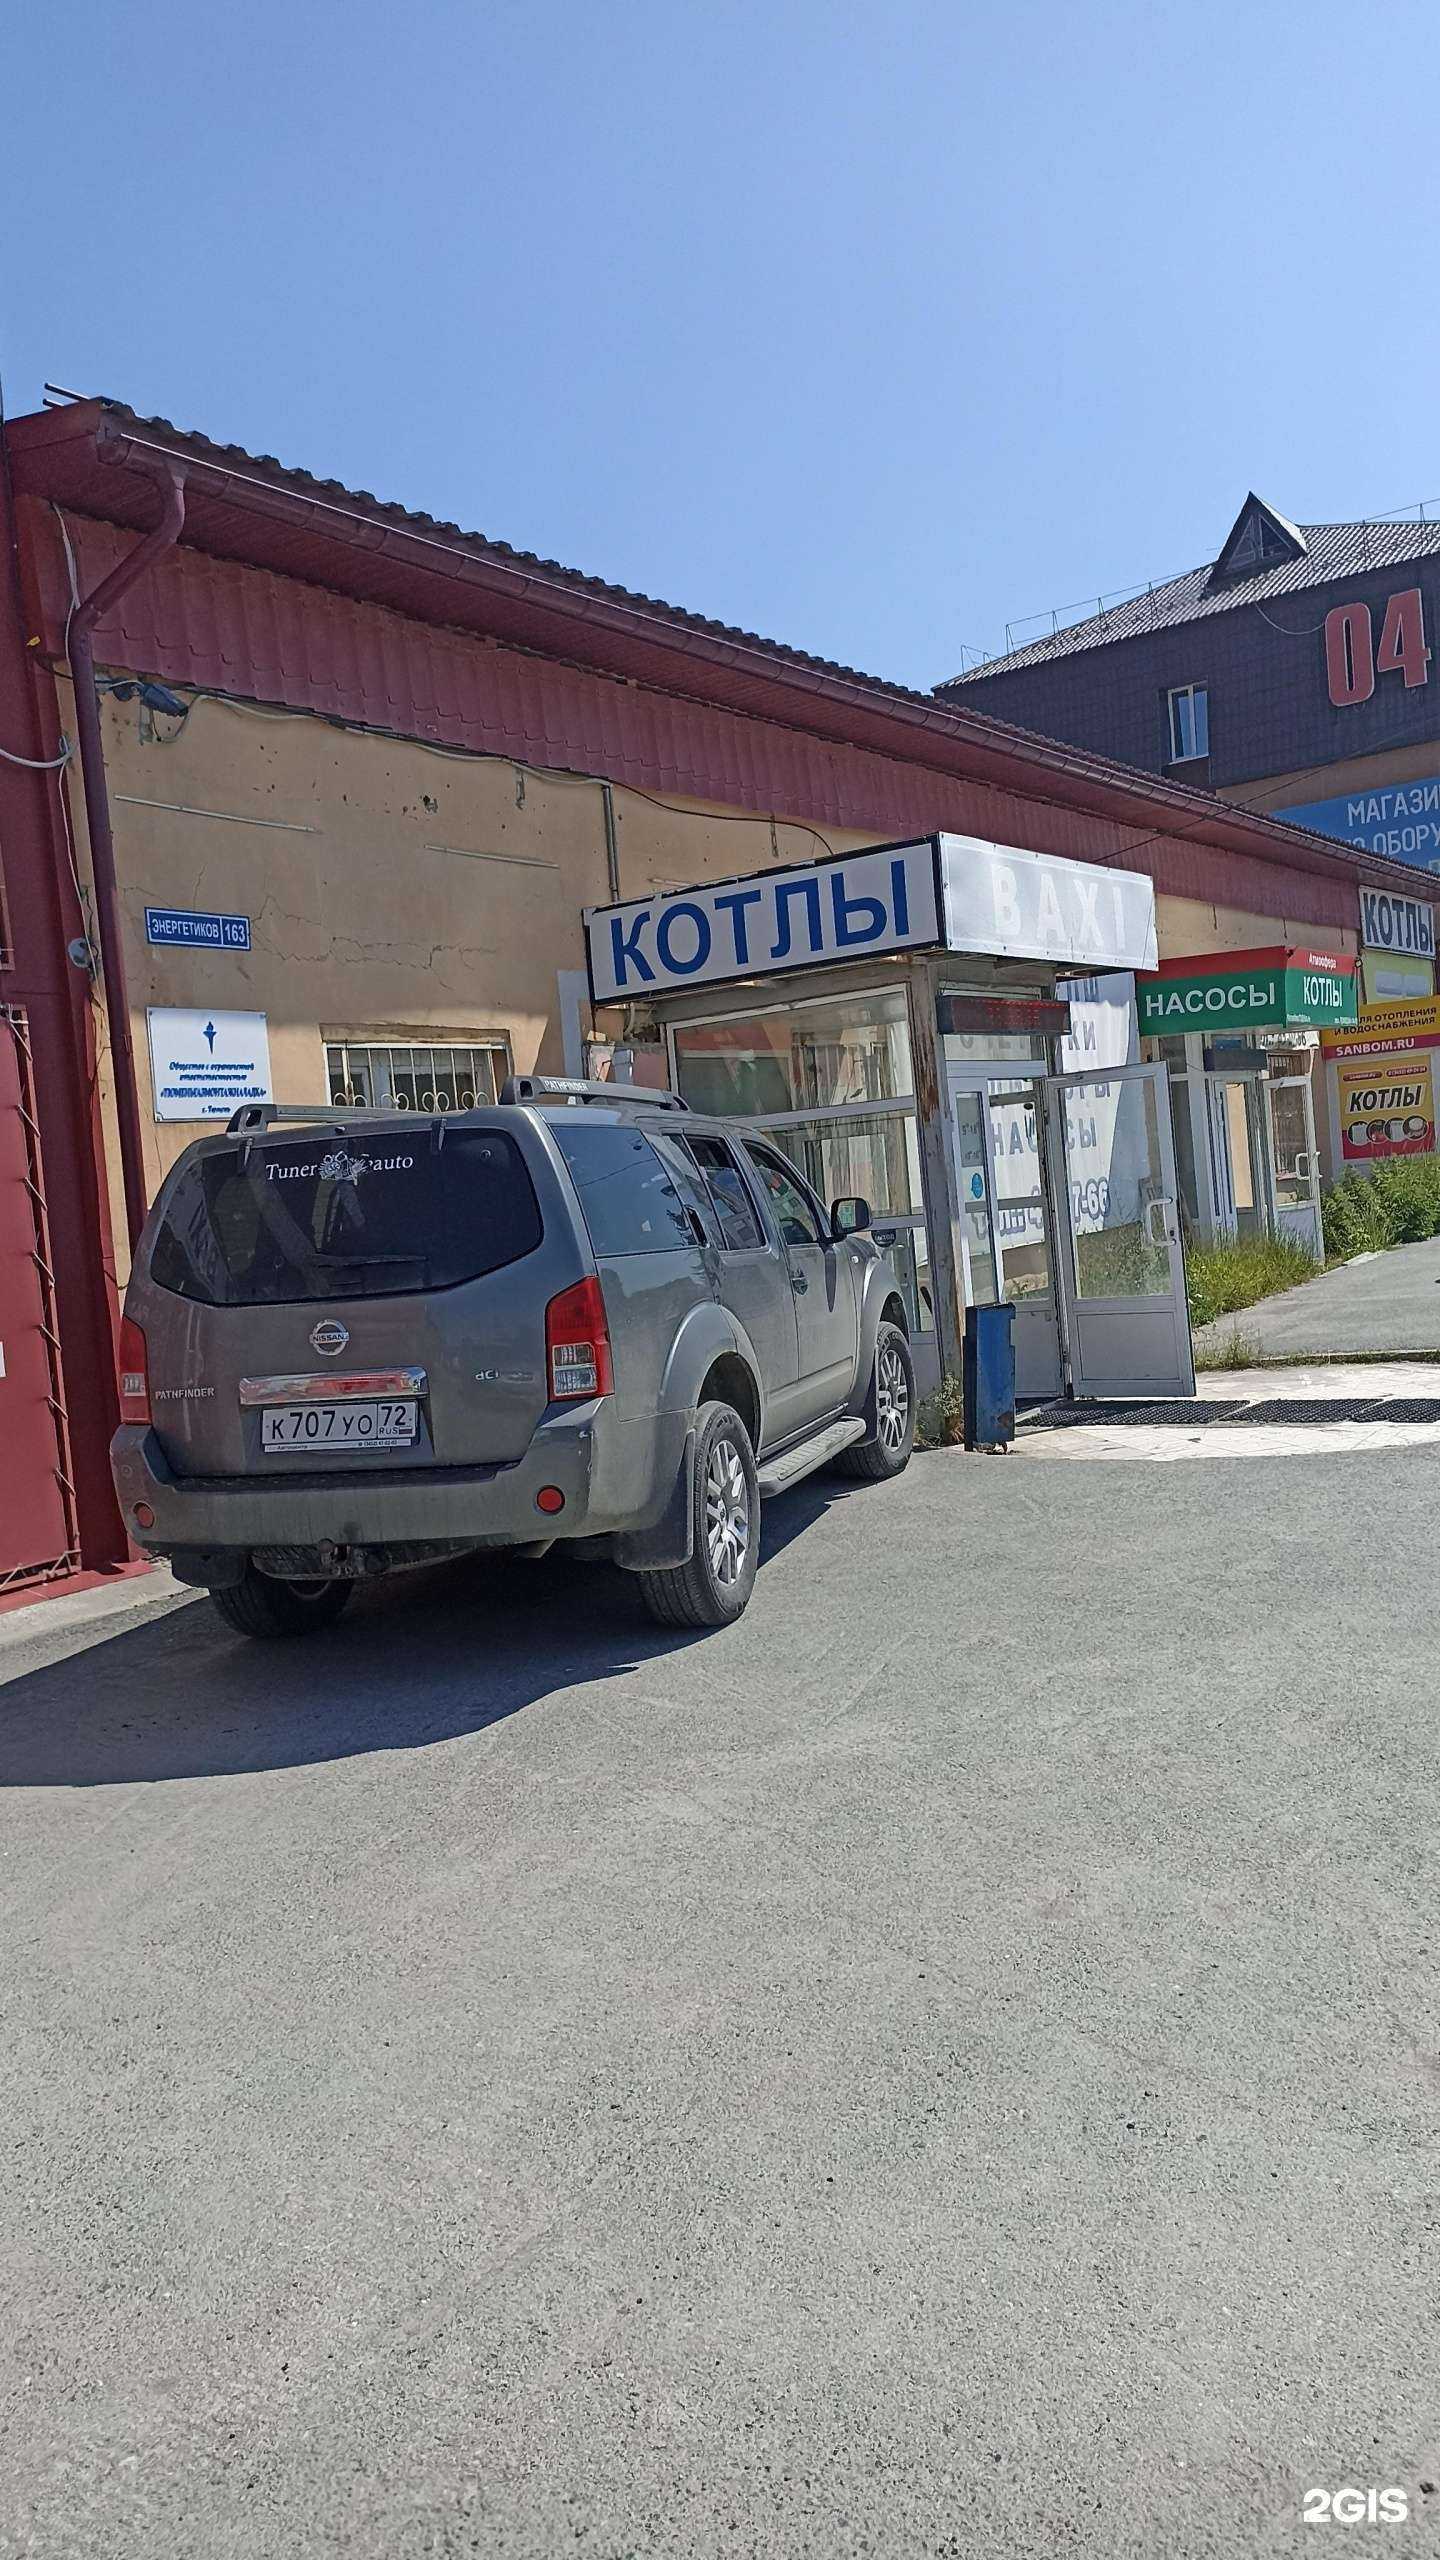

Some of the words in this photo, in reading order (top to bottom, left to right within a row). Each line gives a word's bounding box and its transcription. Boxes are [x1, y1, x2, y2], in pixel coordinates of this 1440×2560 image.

[1324, 588, 1432, 707] 04
[1347, 784, 1440, 827] МАГАЗИ
[991, 863, 1125, 949] BAXI
[152, 918, 219, 938] ЭНЕРГЕТИКОВ
[224, 923, 246, 943] 163
[610, 860, 910, 987] КОТЛЫ
[1363, 892, 1434, 952] КОТЛЫ
[1146, 982, 1275, 1017] НАСОСЫ
[1303, 976, 1342, 1007] КОТЛЫ
[1343, 1016, 1435, 1035] ВОДОСНАБЖЕНИЯ
[1360, 1015, 1372, 1024] ЛЯ
[1375, 1007, 1437, 1022] ОТОПЛЕНИЯ
[1067, 1020, 1097, 1050] КИ
[1336, 1038, 1415, 1056] SANBOM.RU
[544, 1080, 588, 1091] PATHFINDER
[1350, 1085, 1422, 1112] КОТЛЫ
[265, 1163, 318, 1180] Tuner
[155, 1387, 215, 1400] PATHFINDER
[381, 1405, 407, 1426] 72
[379, 1427, 399, 1435] RUS
